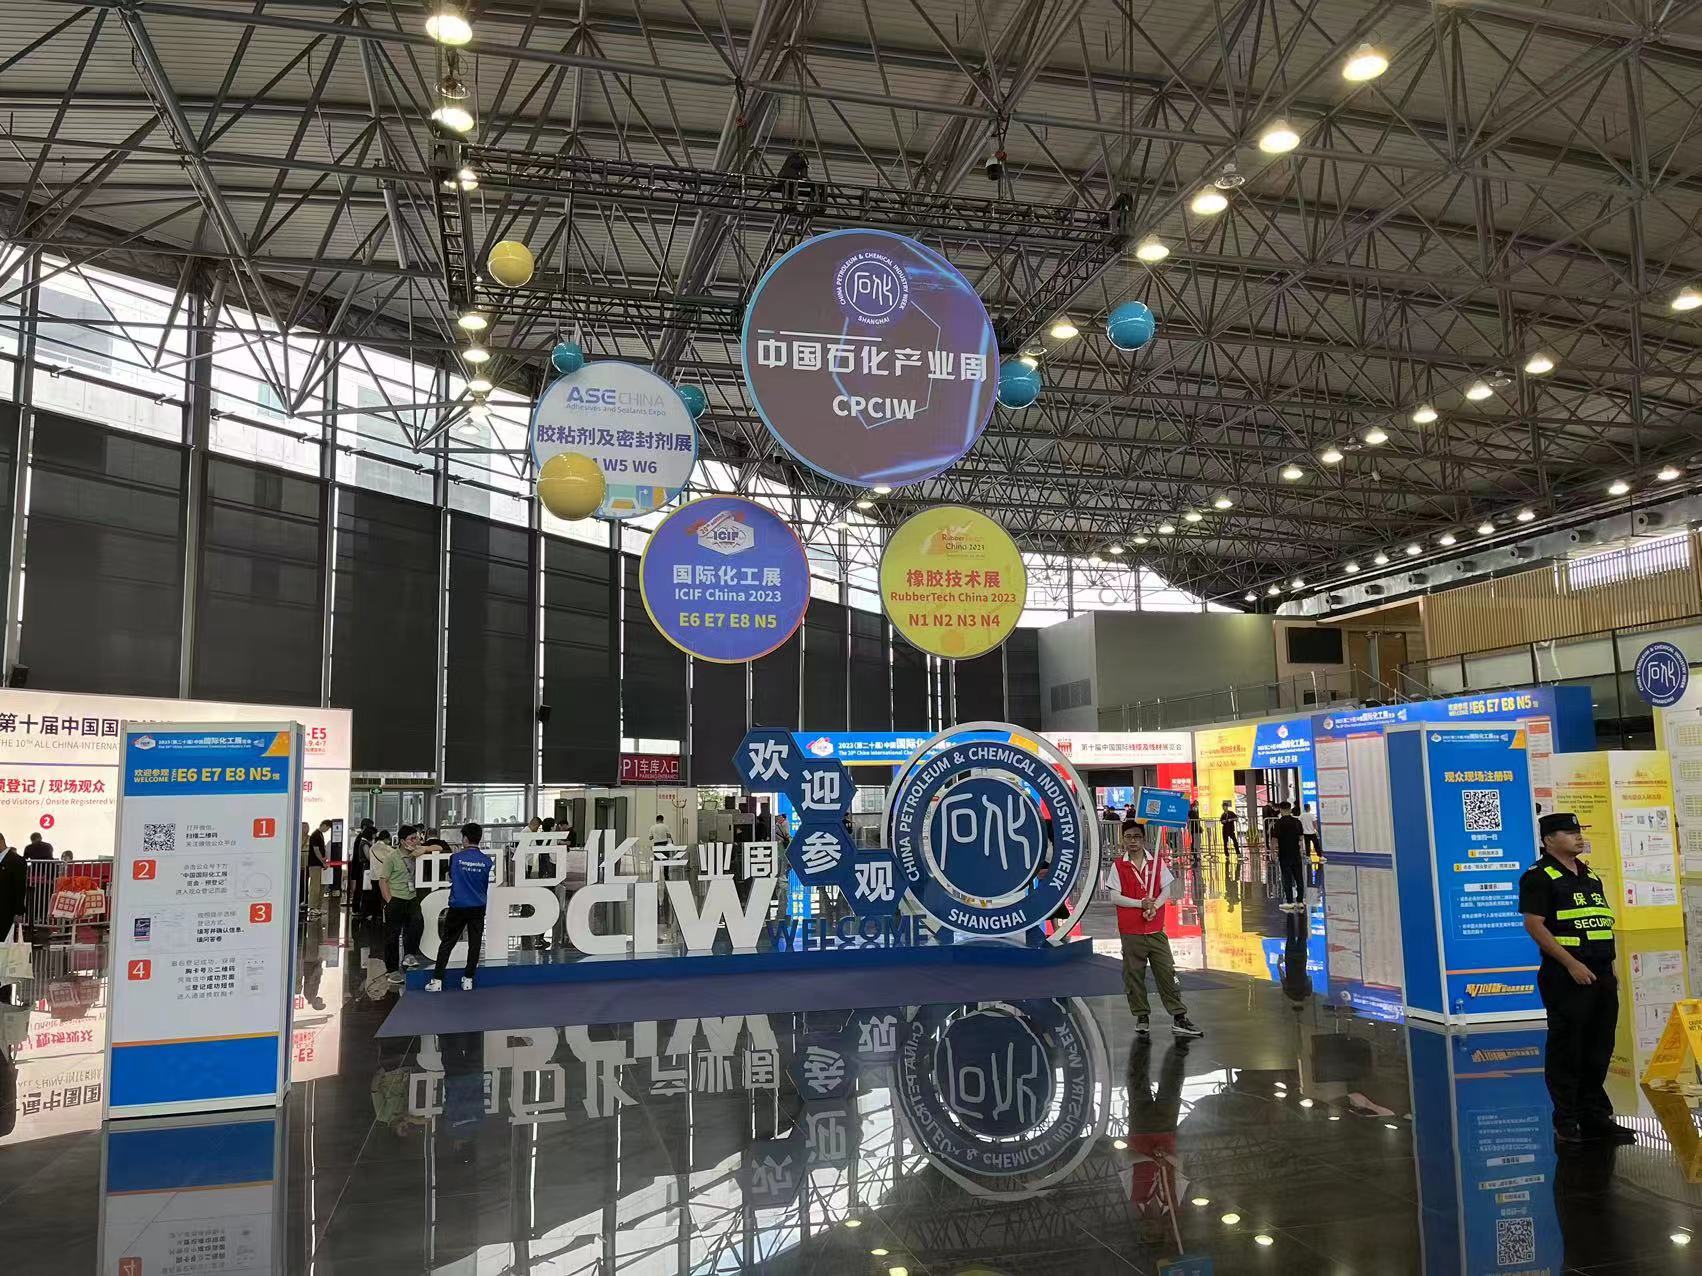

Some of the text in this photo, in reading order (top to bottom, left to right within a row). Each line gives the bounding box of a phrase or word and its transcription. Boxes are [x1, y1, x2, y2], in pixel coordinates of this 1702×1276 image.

[865, 252, 893, 266] CHEMICAL
[836, 256, 857, 286] PETROLEUM
[893, 264, 909, 293] INDUSTRY
[837, 286, 846, 305] CHINA
[899, 293, 909, 310] WEEK
[857, 315, 890, 325] SHANGHAI
[757, 338, 987, 383] 中国石化产业周
[566, 386, 665, 407] ASE CHINA
[566, 403, 666, 416] Adhesives and Sealants Expo
[832, 395, 917, 420] CPCIW
[536, 424, 693, 452] 胶粘剂及密封剂展
[603, 458, 657, 474] W5 W6
[713, 531, 739, 541] ICIF
[673, 564, 782, 587] 国际化工展
[906, 569, 1001, 588] 橡胶技术展
[675, 588, 782, 602] ICIF China 2023
[890, 591, 1017, 603] RubberTech China 2023
[680, 612, 777, 628] E6 E7 E8 N5
[909, 613, 1001, 627] N1 N2 N3 N4
[1473, 700, 1485, 714] E6
[1486, 699, 1499, 713] E7
[1501, 697, 1515, 711] E8
[1516, 695, 1532, 710] N5
[0, 739, 13, 748] HE
[35, 741, 51, 749] ALL
[52, 742, 119, 751] CHINA-INTERNA
[134, 769, 170, 777] 欢迎参观
[640, 758, 679, 773] 车库入口
[177, 768, 198, 782] E6
[201, 768, 222, 781] E7
[225, 768, 246, 781] E8
[250, 767, 272, 780] N5
[1444, 771, 1514, 782] 观众现场注册码
[48, 779, 106, 794] 现场观众
[13, 798, 39, 806] Visitors
[46, 798, 69, 806] Onsite
[71, 798, 107, 807] Registered
[898, 747, 1076, 892] CHINA PETROLEUM & CHEMICAL INDUSTRY WEEK
[259, 820, 269, 836] 1
[415, 828, 779, 889] 中石化产业周
[138, 861, 150, 878] 2
[1573, 892, 1605, 906] 保安
[254, 905, 266, 921] 3
[948, 908, 1027, 930] SHANGHAI
[766, 914, 929, 943] WELCOME
[132, 961, 146, 978] 4
